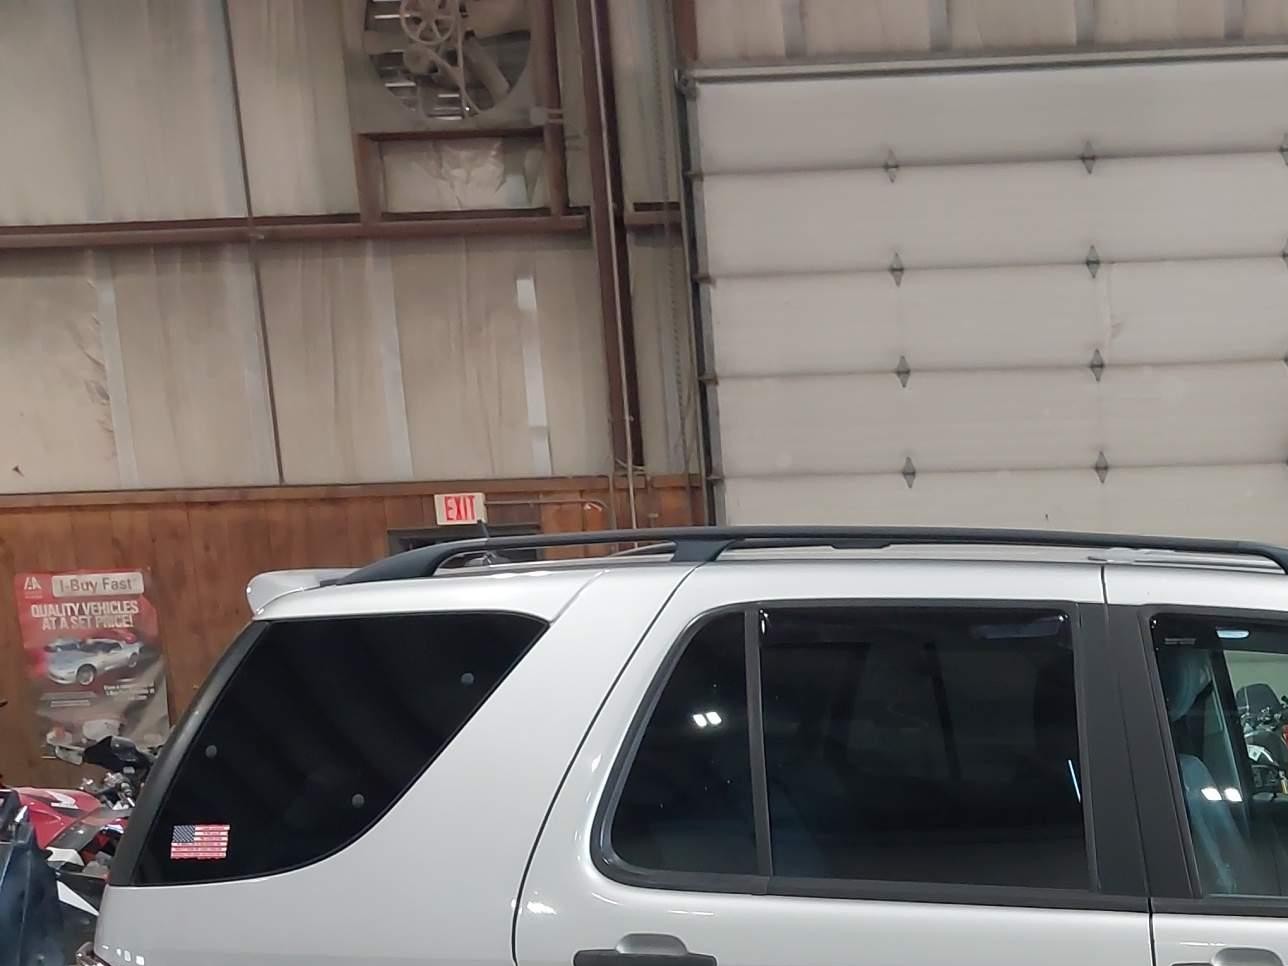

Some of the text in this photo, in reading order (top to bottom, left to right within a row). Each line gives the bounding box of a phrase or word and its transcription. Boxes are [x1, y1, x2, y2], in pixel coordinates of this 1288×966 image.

[444, 495, 476, 521] EXIT
[102, 577, 133, 590] Fast
[31, 600, 139, 618] QUALITY VEHICLES
[42, 614, 134, 631] AT A SET PRICE!
